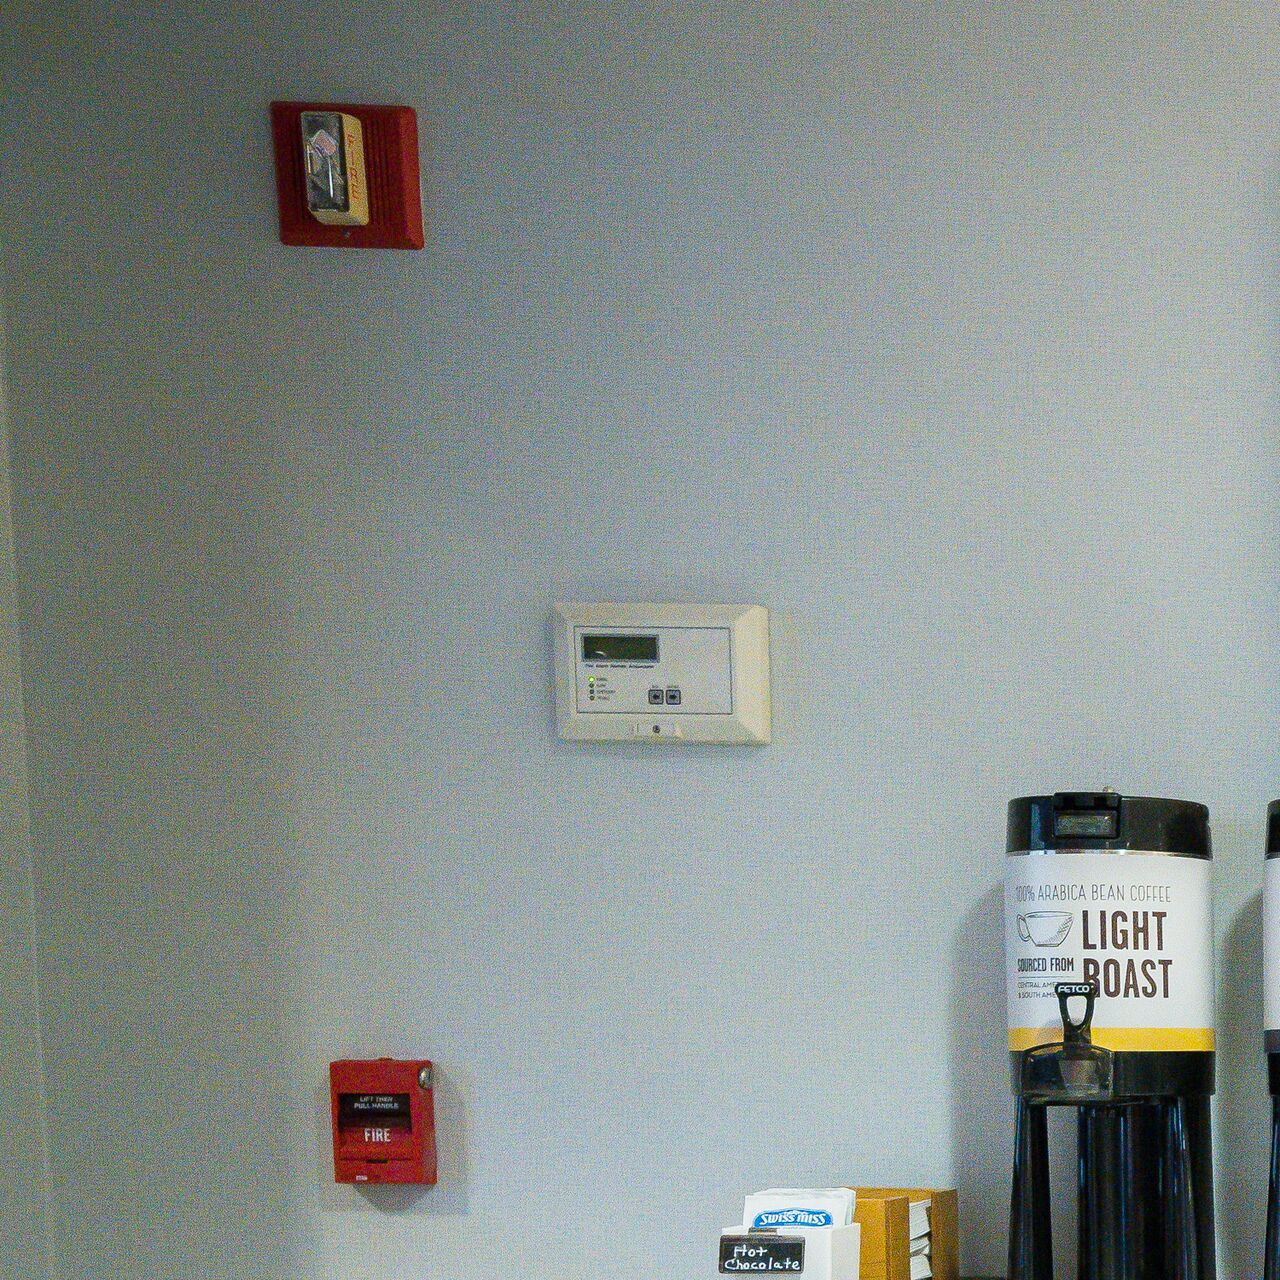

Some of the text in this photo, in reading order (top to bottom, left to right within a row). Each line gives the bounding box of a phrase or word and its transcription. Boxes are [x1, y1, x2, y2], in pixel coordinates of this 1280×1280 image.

[1037, 884, 1087, 901] ARABICA
[1091, 884, 1125, 901] BEAN
[1130, 885, 1171, 903] COFFEE
[1082, 910, 1168, 951] LIGHT
[1017, 957, 1074, 972] SOURCED FROM
[1058, 985, 1090, 993] FETCO
[364, 1128, 391, 1143] FIRE
[733, 1244, 768, 1258] Hot
[724, 1258, 800, 1271] Chocolate
